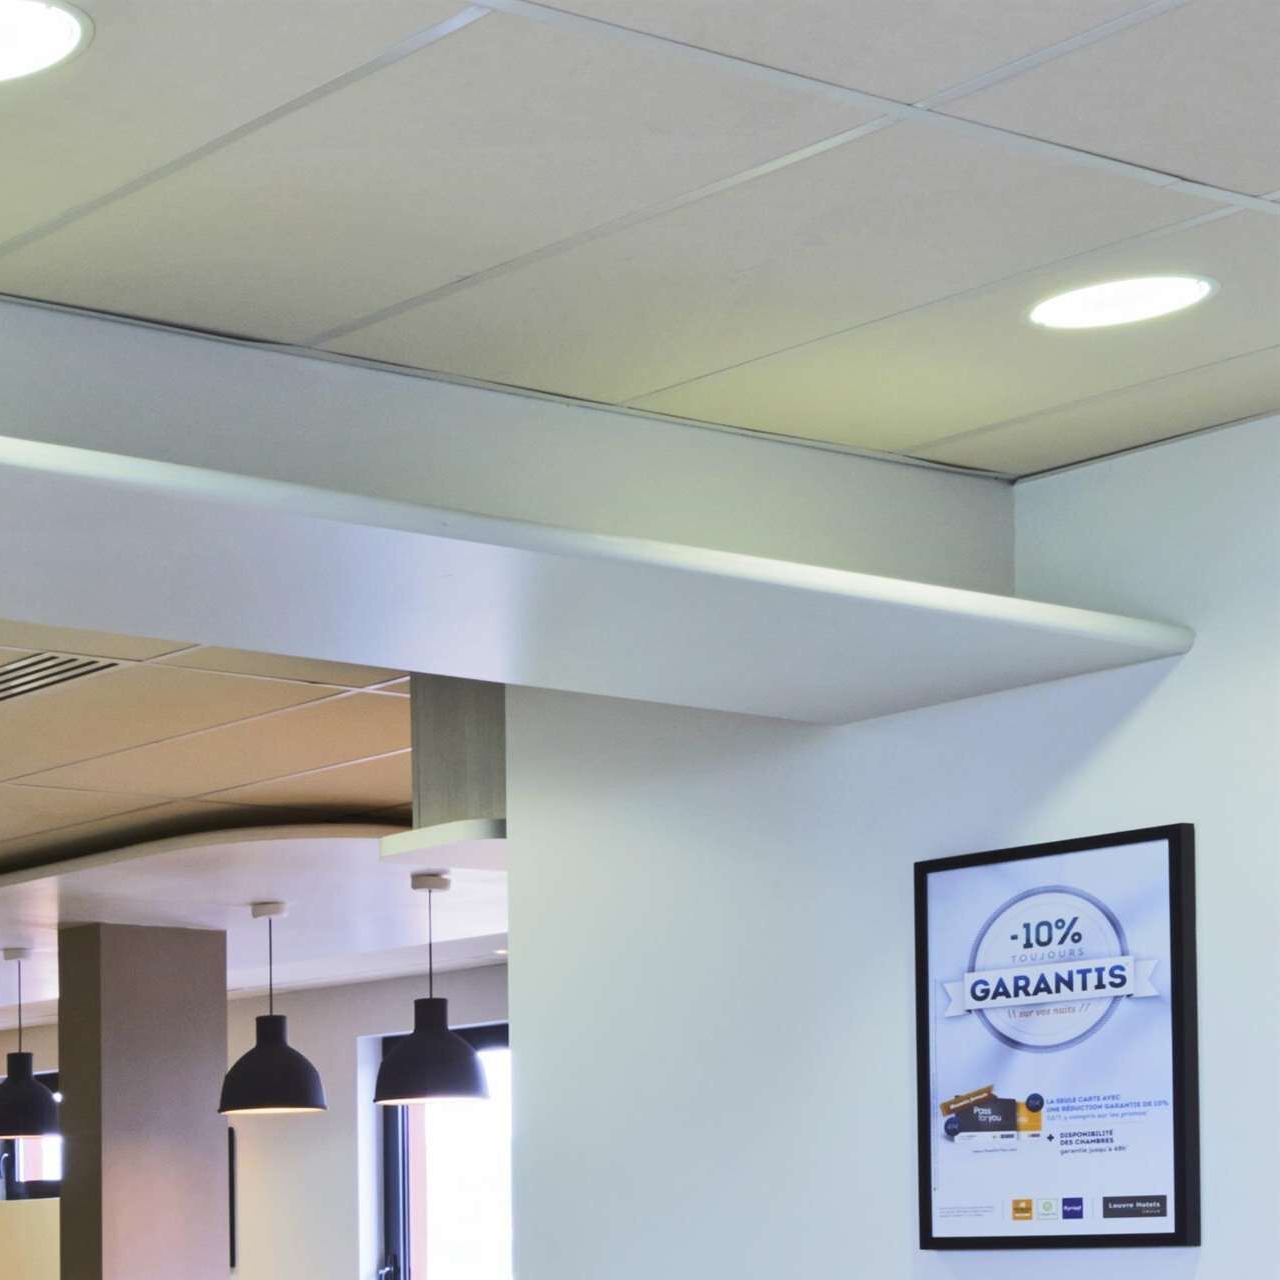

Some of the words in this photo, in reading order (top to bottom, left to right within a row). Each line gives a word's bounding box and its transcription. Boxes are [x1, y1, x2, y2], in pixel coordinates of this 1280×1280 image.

[1010, 916, 1082, 949] -10%
[1011, 948, 1084, 963] TOUJOURS
[970, 964, 1127, 1002] GARANTIS
[973, 1107, 991, 1115] Pass
